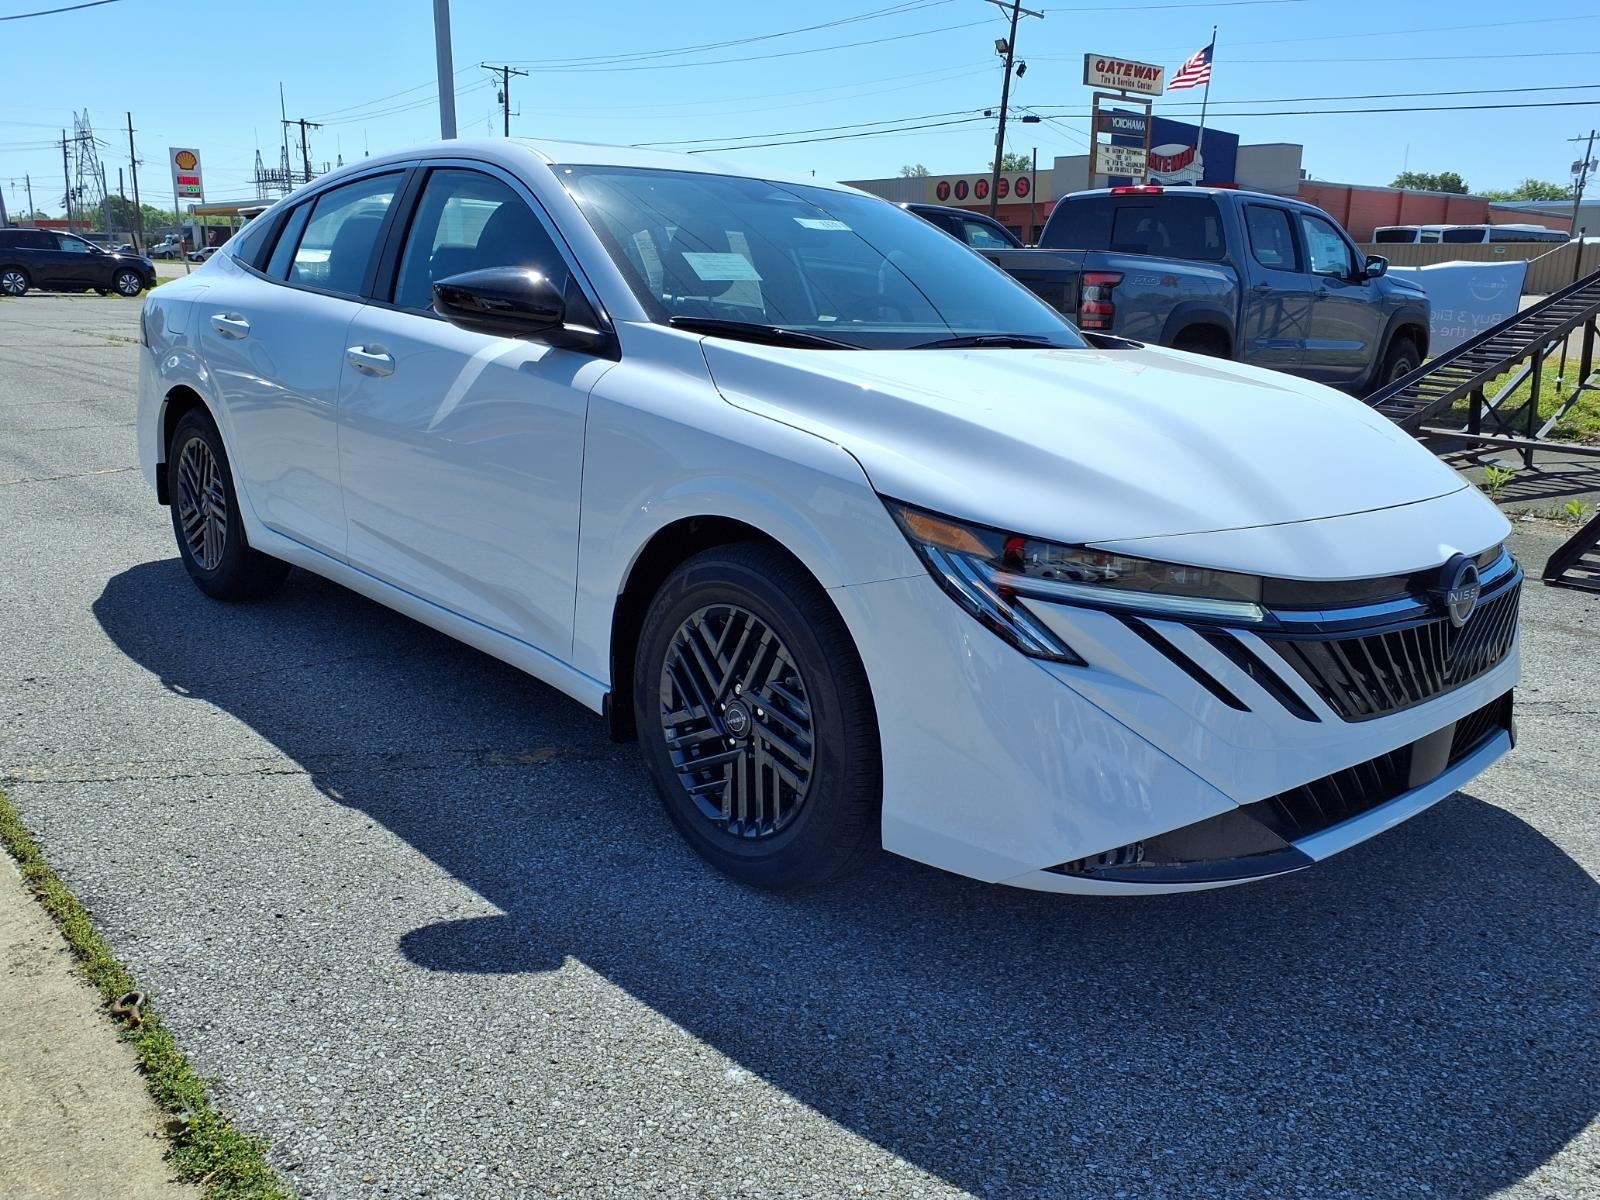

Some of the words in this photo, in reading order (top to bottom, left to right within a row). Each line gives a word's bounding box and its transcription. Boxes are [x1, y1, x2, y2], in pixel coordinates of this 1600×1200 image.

[1095, 59, 1161, 80] GATEWAY
[1101, 74, 1111, 85] Tire
[1117, 76, 1135, 88] Service
[1136, 80, 1153, 91] Center
[1112, 117, 1145, 131] YOKOHAMA
[937, 177, 1030, 201] TIRES
[1449, 589, 1478, 602] NISS
